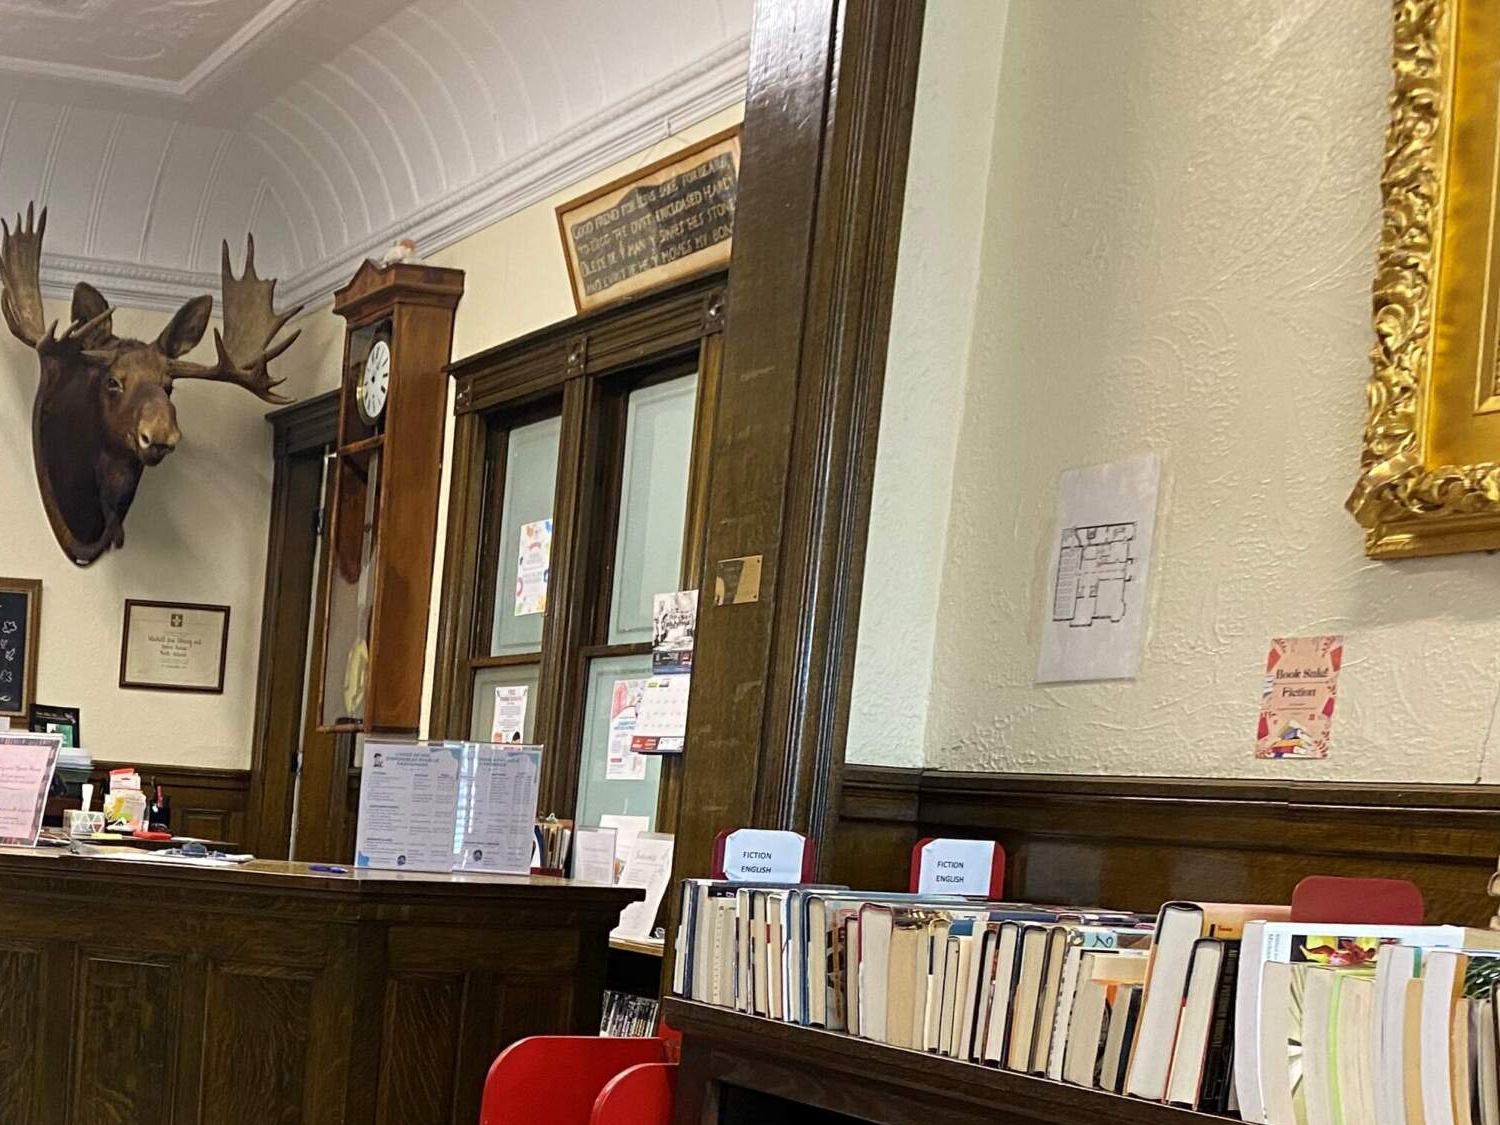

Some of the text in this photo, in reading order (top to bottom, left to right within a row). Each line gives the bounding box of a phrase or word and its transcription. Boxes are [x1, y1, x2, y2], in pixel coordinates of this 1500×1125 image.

[1275, 667, 1329, 679] Book Sale!
[1282, 687, 1316, 697] Fiction
[742, 851, 772, 860] FICTION
[740, 865, 772, 874] ENGLISH
[937, 861, 964, 869] FICTION
[935, 875, 965, 883] ENGLISH
